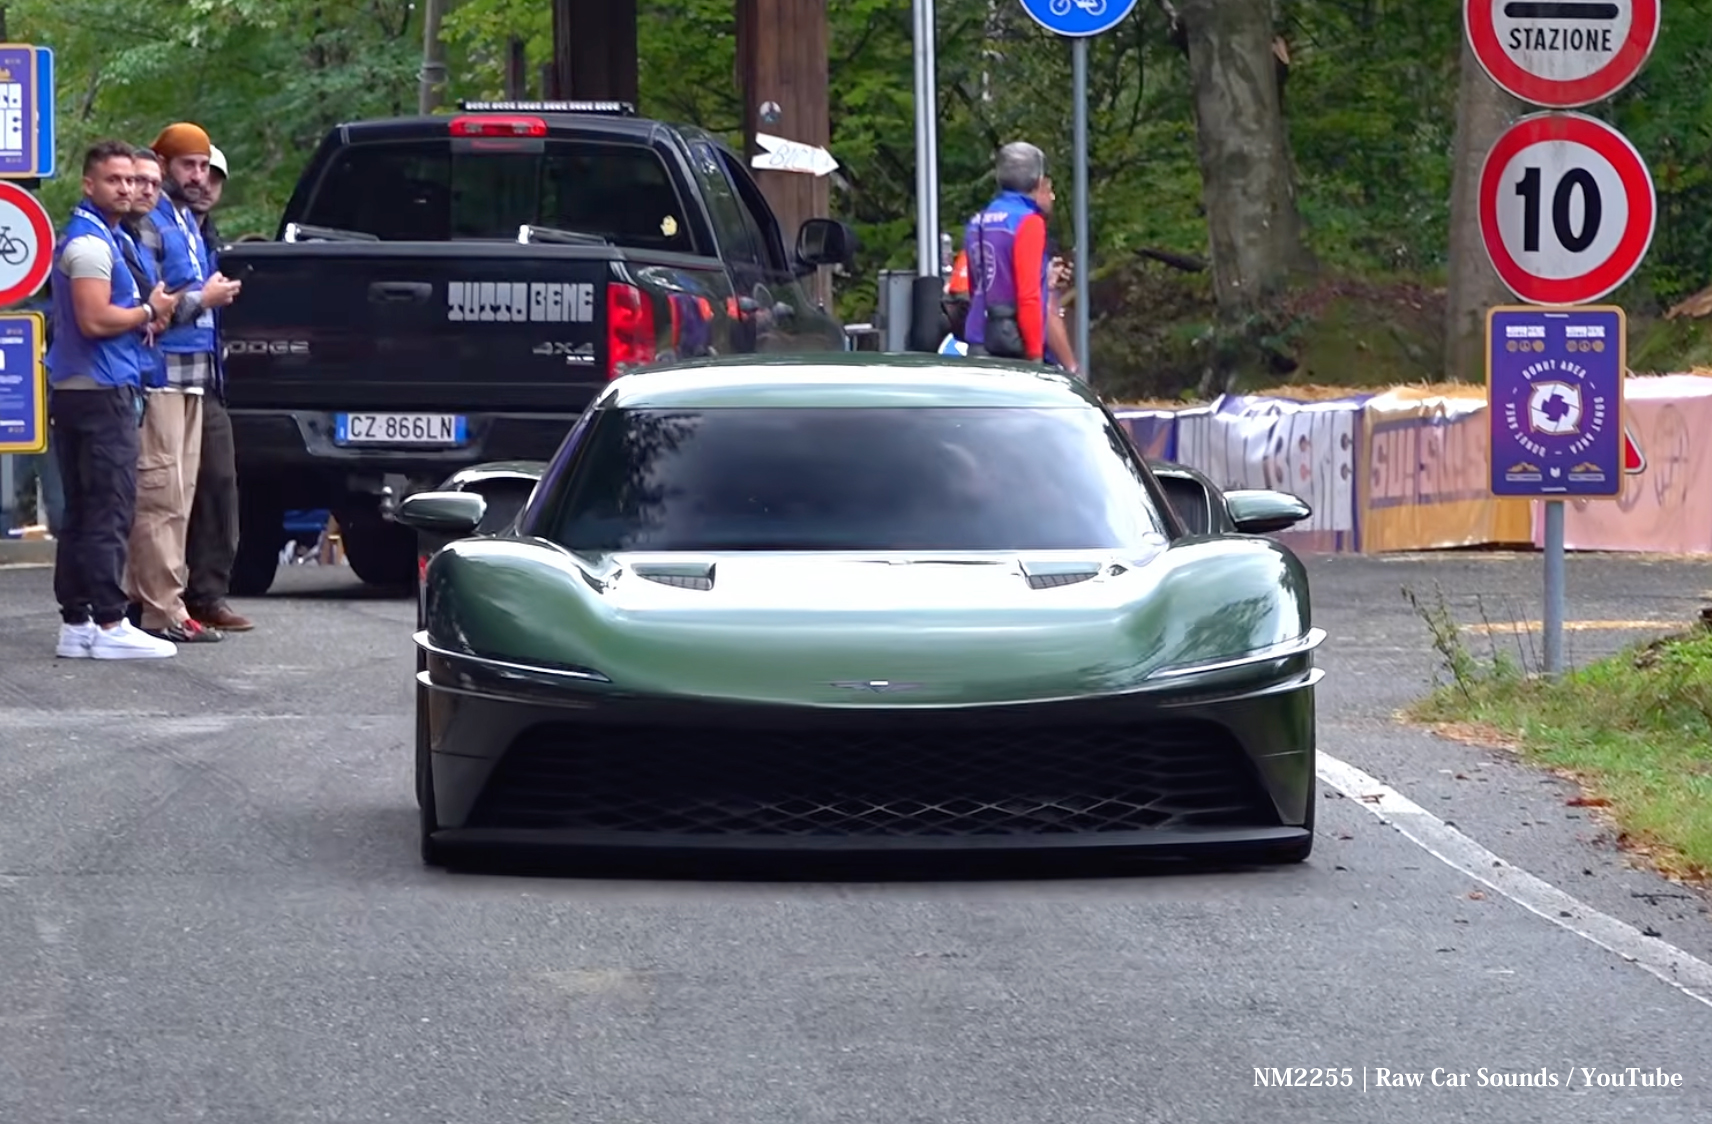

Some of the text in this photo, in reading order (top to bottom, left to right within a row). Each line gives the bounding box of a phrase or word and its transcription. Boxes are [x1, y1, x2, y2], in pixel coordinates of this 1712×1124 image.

[1508, 27, 1613, 52] STAZIONE
[1515, 166, 1602, 253] 10
[448, 281, 594, 322] TUTTO BENE
[229, 340, 310, 354] ODGE
[1522, 359, 1587, 380] DONUT AREA
[351, 416, 377, 438] CZ
[385, 416, 453, 439] 866LN
